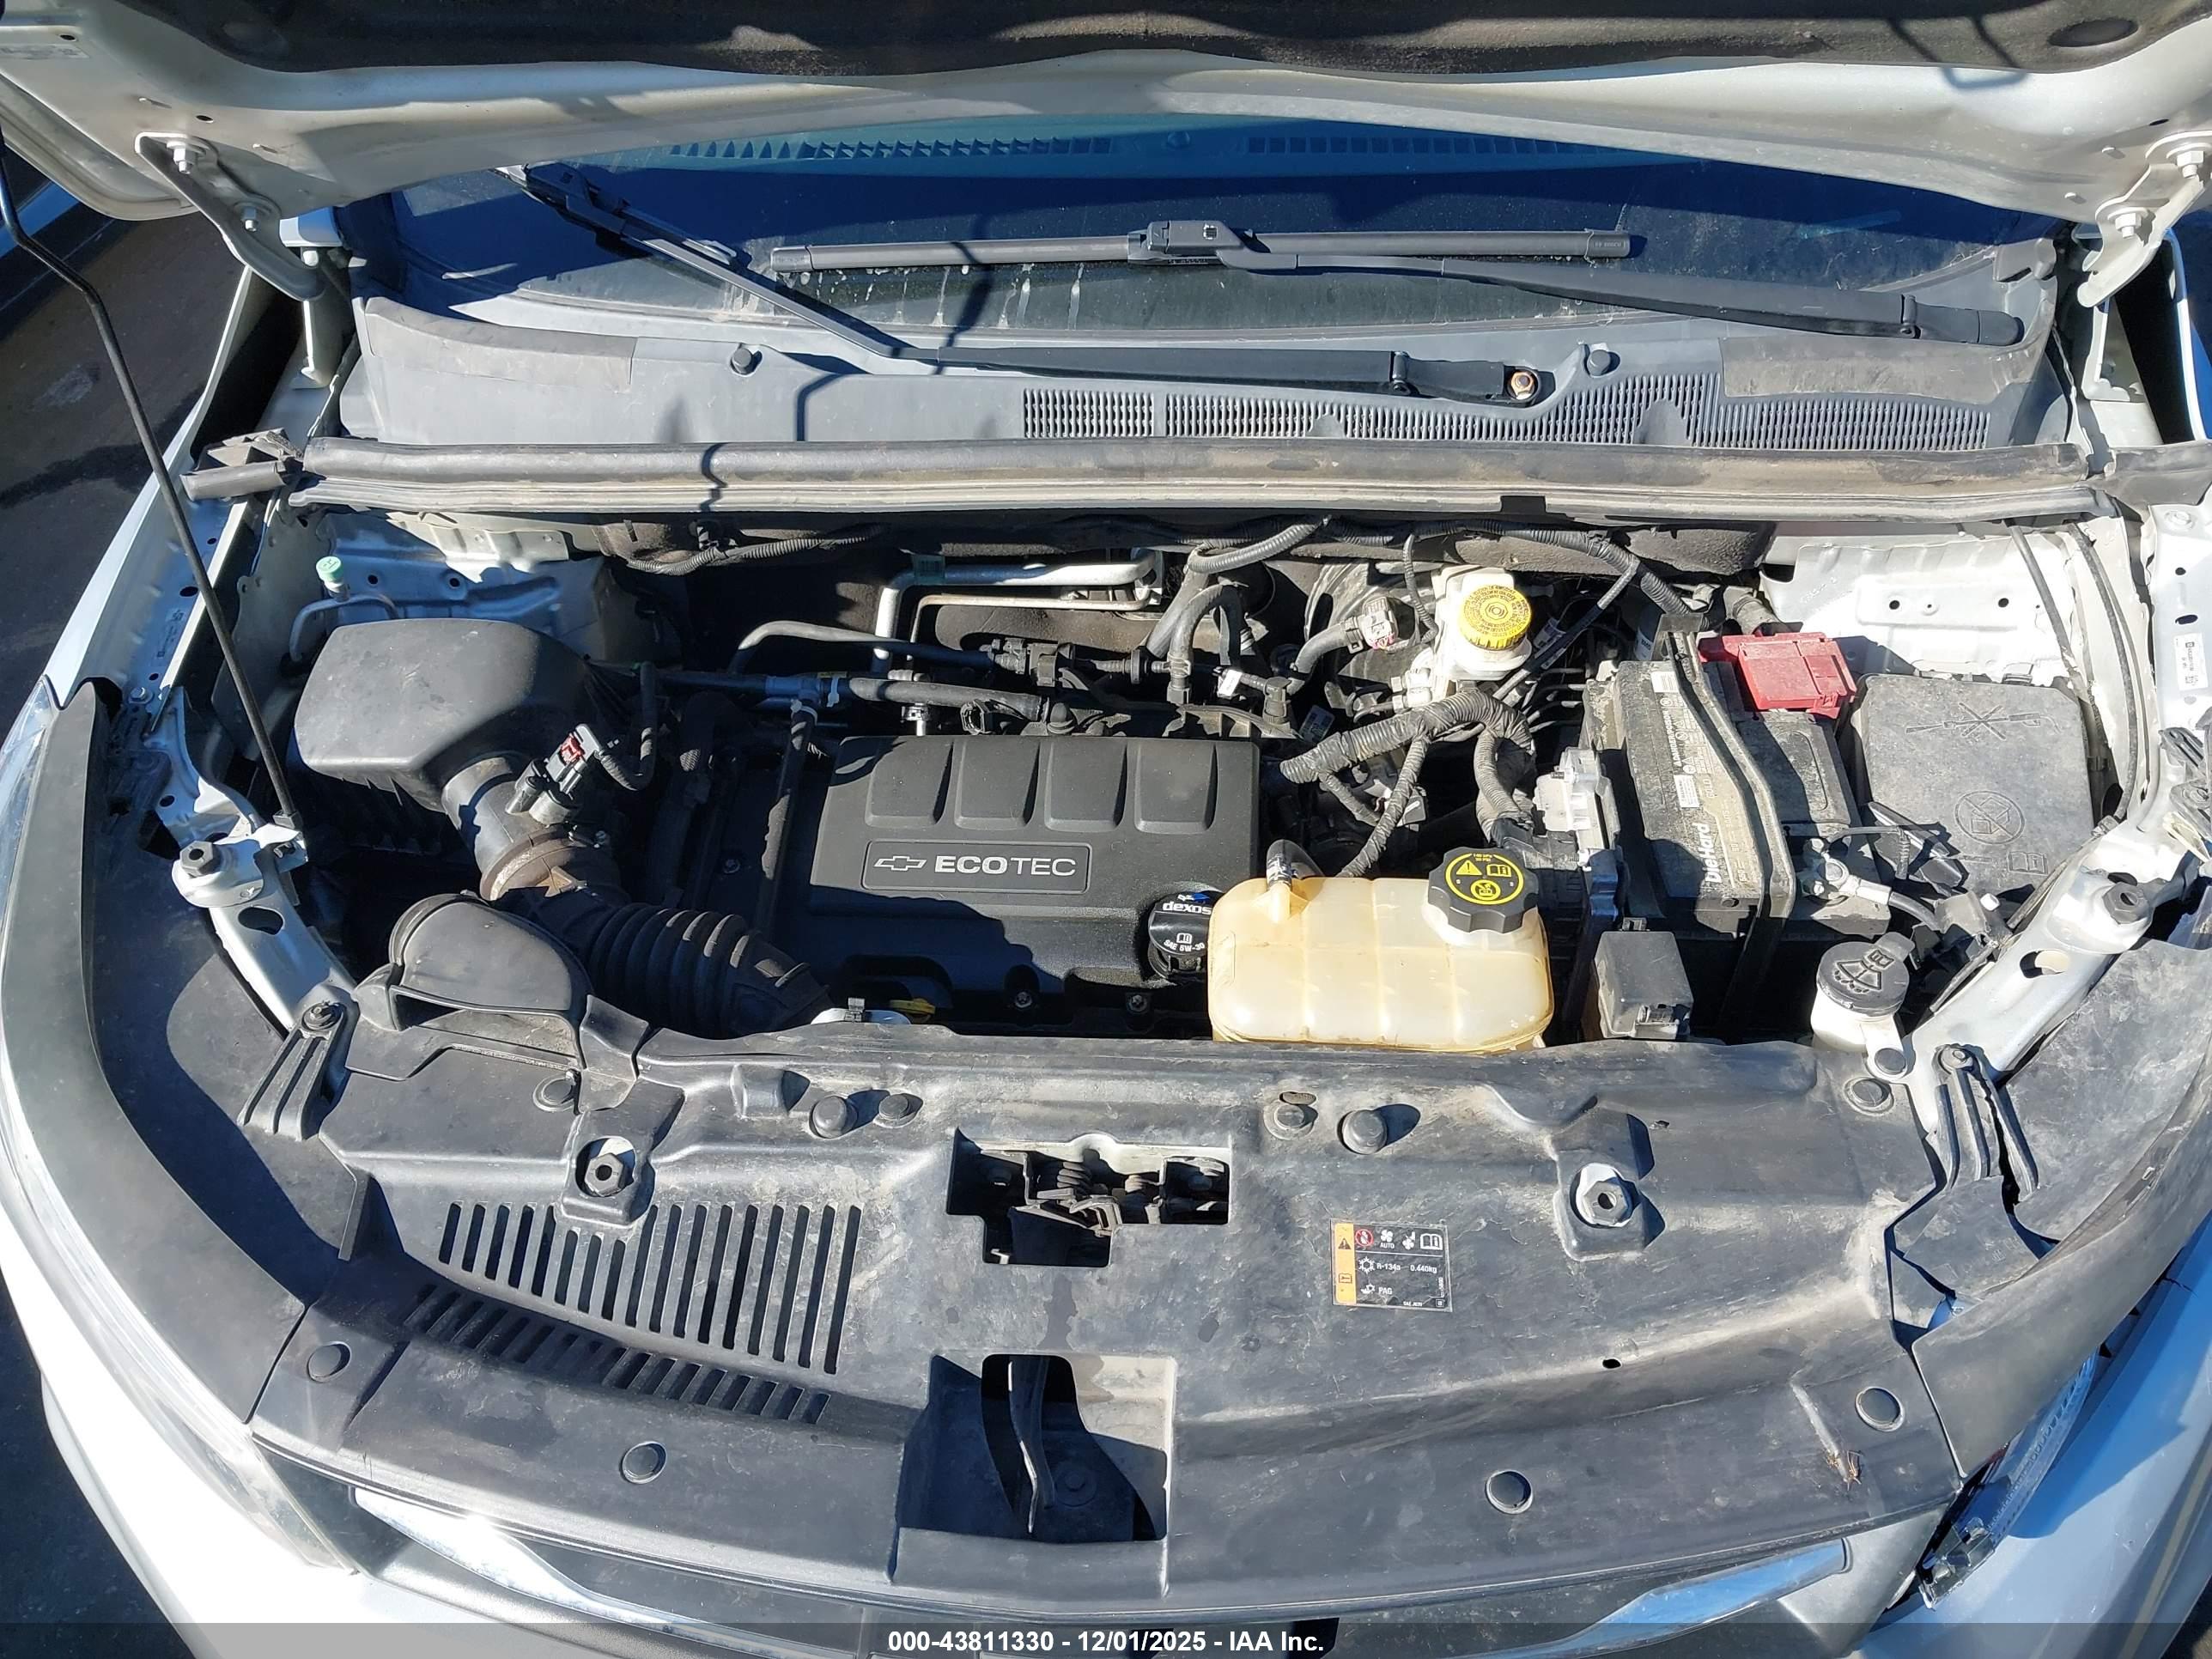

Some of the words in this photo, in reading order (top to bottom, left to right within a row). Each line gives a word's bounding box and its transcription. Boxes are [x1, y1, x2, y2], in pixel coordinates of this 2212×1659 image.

[1662, 710, 1680, 761] DANGER/POISON
[1691, 822, 1723, 884] DieHard
[934, 855, 1076, 877] ECOTEC
[1162, 901, 1212, 915] dexos
[1164, 939, 1178, 951] SAE
[1179, 942, 1206, 952] 5W-30
[1376, 1262, 1401, 1272] R-134a
[1410, 1264, 1437, 1274] 0.440kg
[1378, 1286, 1393, 1295] PAG
